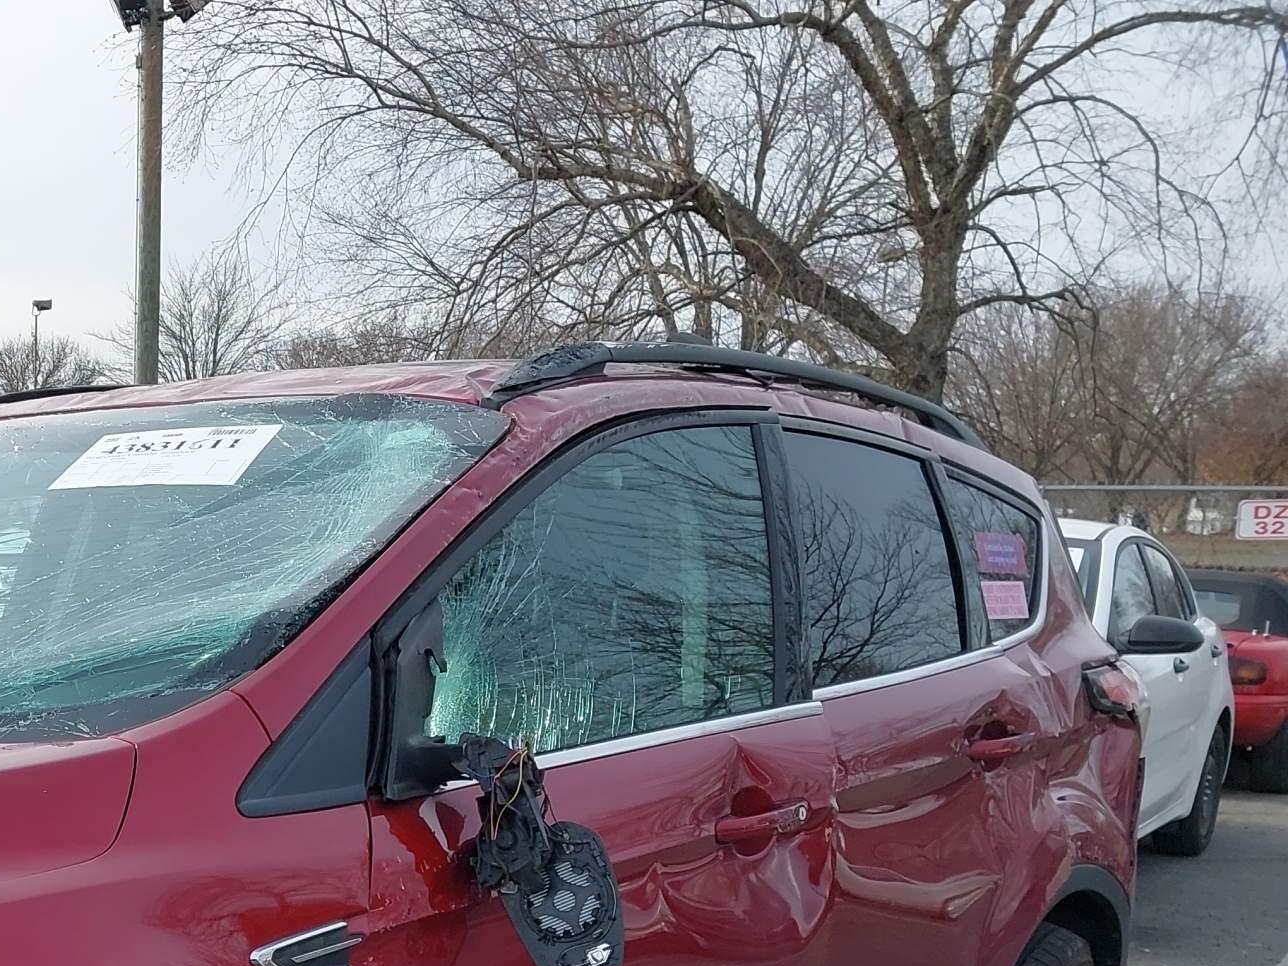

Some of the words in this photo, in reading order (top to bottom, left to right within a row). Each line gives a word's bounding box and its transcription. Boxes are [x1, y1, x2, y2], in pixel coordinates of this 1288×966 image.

[100, 438, 242, 455] 43831611
[1254, 505, 1288, 519] DZ
[1254, 521, 1285, 535] 32
